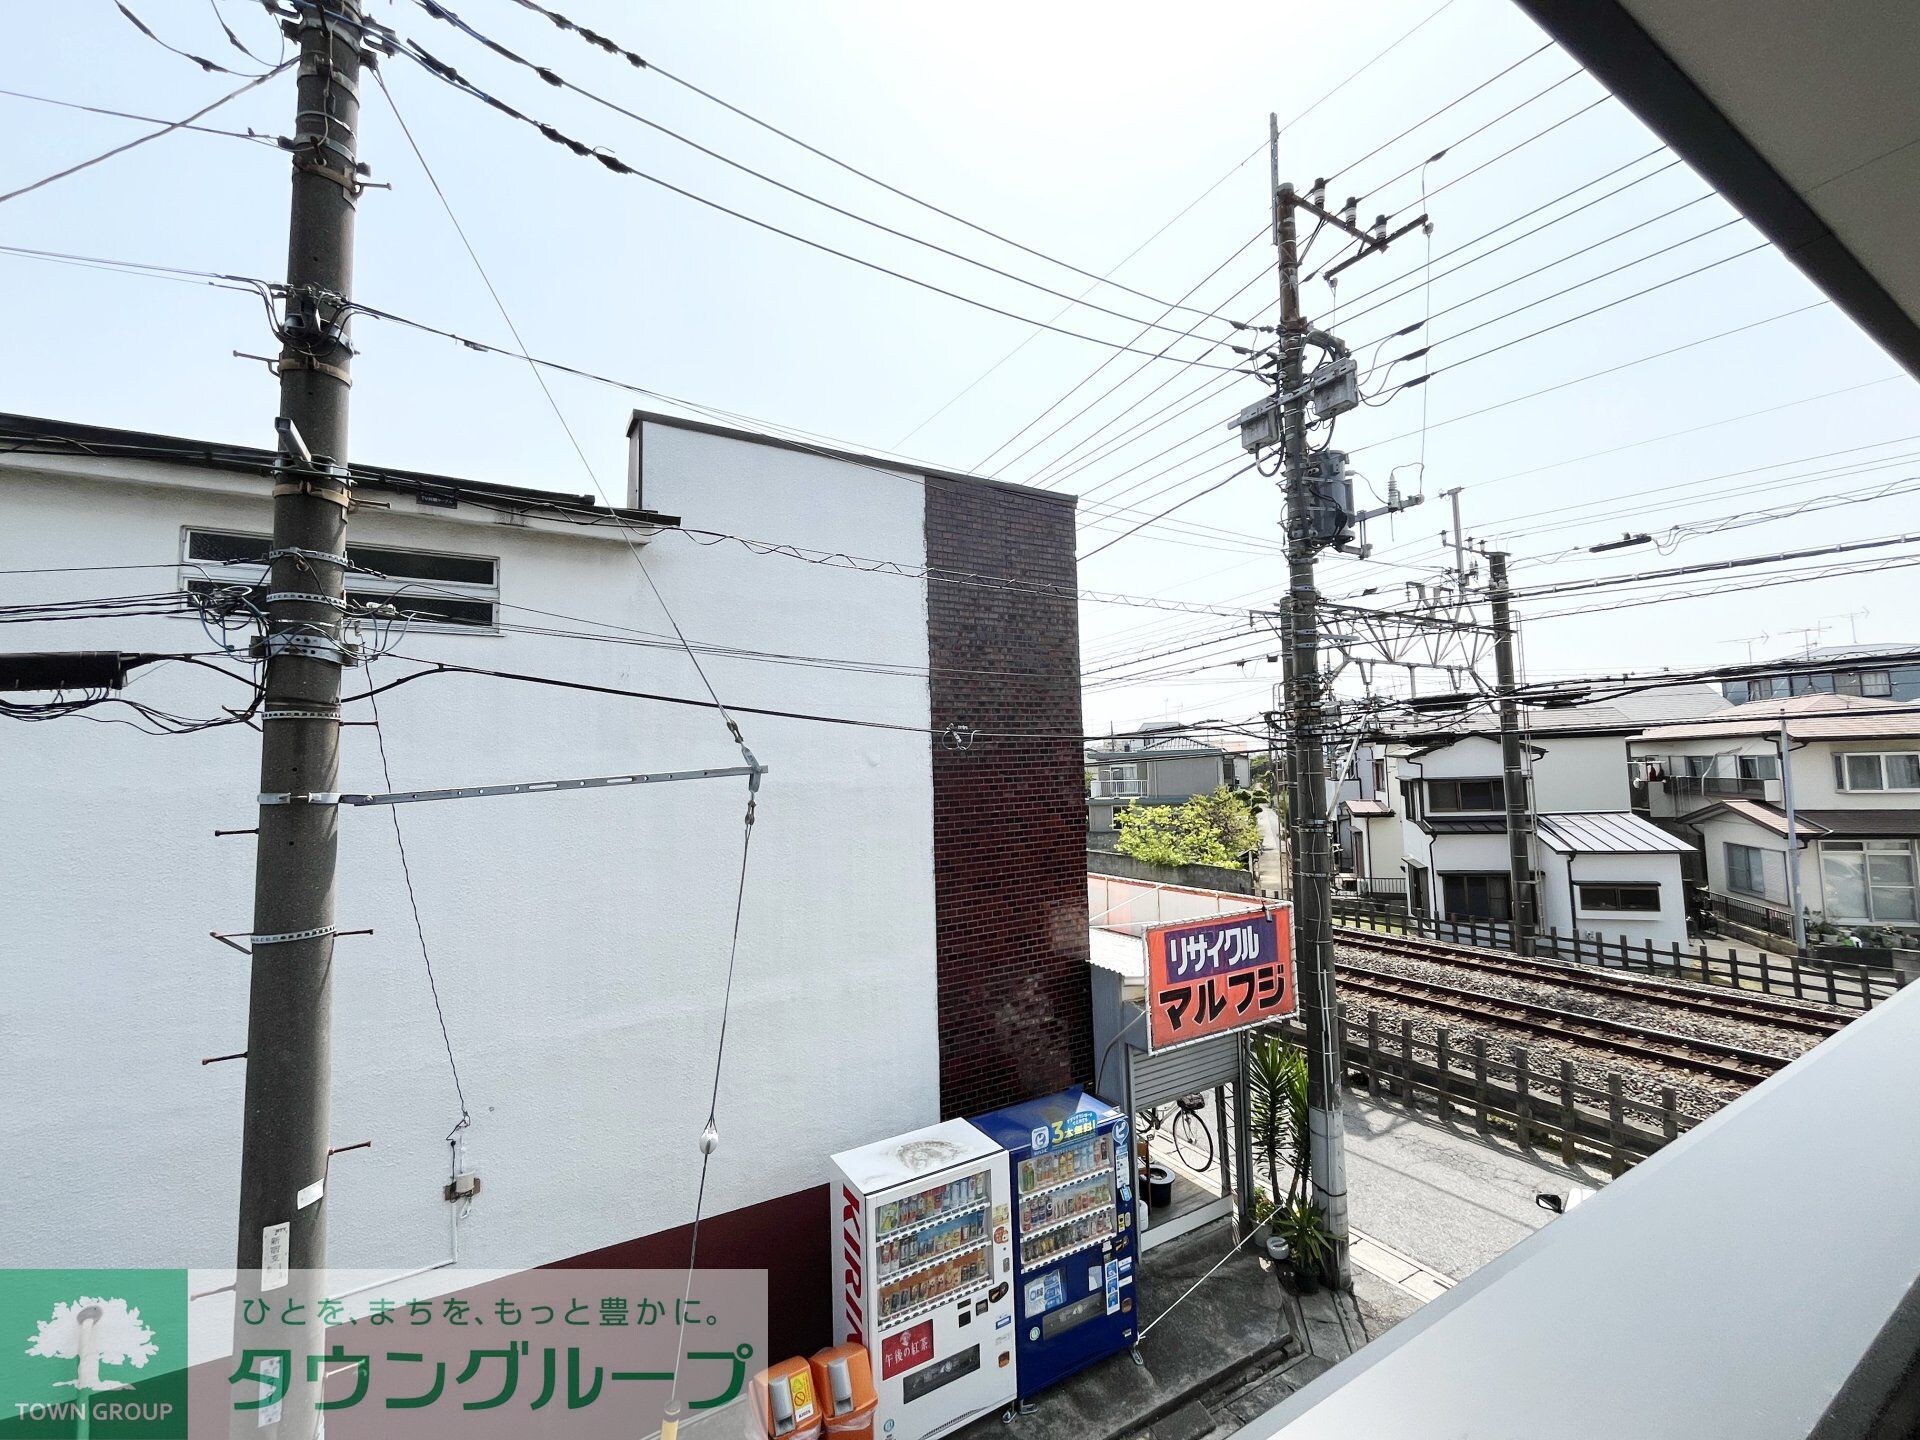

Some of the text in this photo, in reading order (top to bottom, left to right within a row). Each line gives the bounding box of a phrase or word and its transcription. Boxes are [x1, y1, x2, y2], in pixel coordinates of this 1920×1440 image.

[1170, 925, 1260, 976] リサイクル
[1158, 964, 1286, 1032] マルフジ
[884, 1336, 929, 1368] 午後の紅茶
